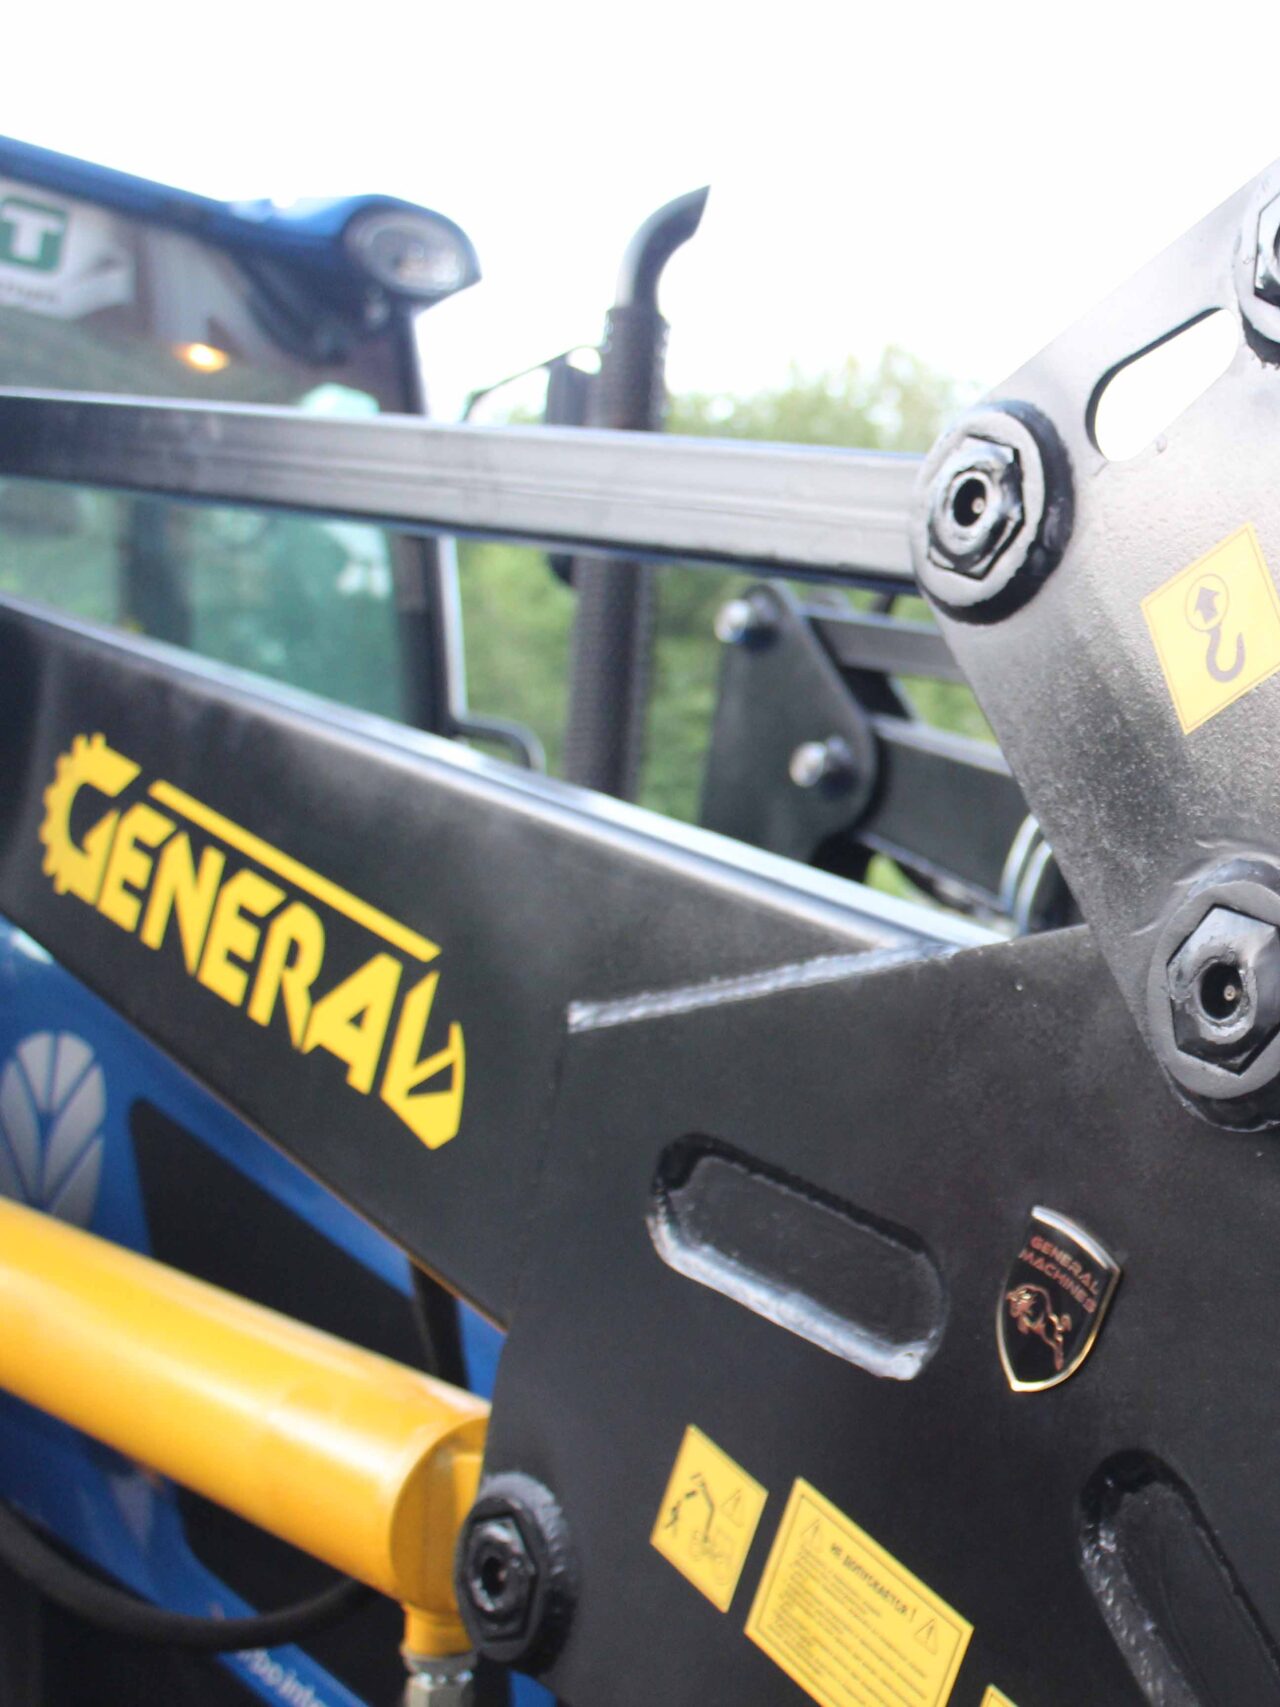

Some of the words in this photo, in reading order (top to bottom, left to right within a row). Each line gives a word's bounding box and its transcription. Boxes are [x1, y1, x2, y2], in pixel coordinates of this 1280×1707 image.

[39, 733, 466, 1150] GENERAL
[1017, 1248, 1098, 1313] MACHINES
[1029, 1234, 1099, 1296] GENERAL
